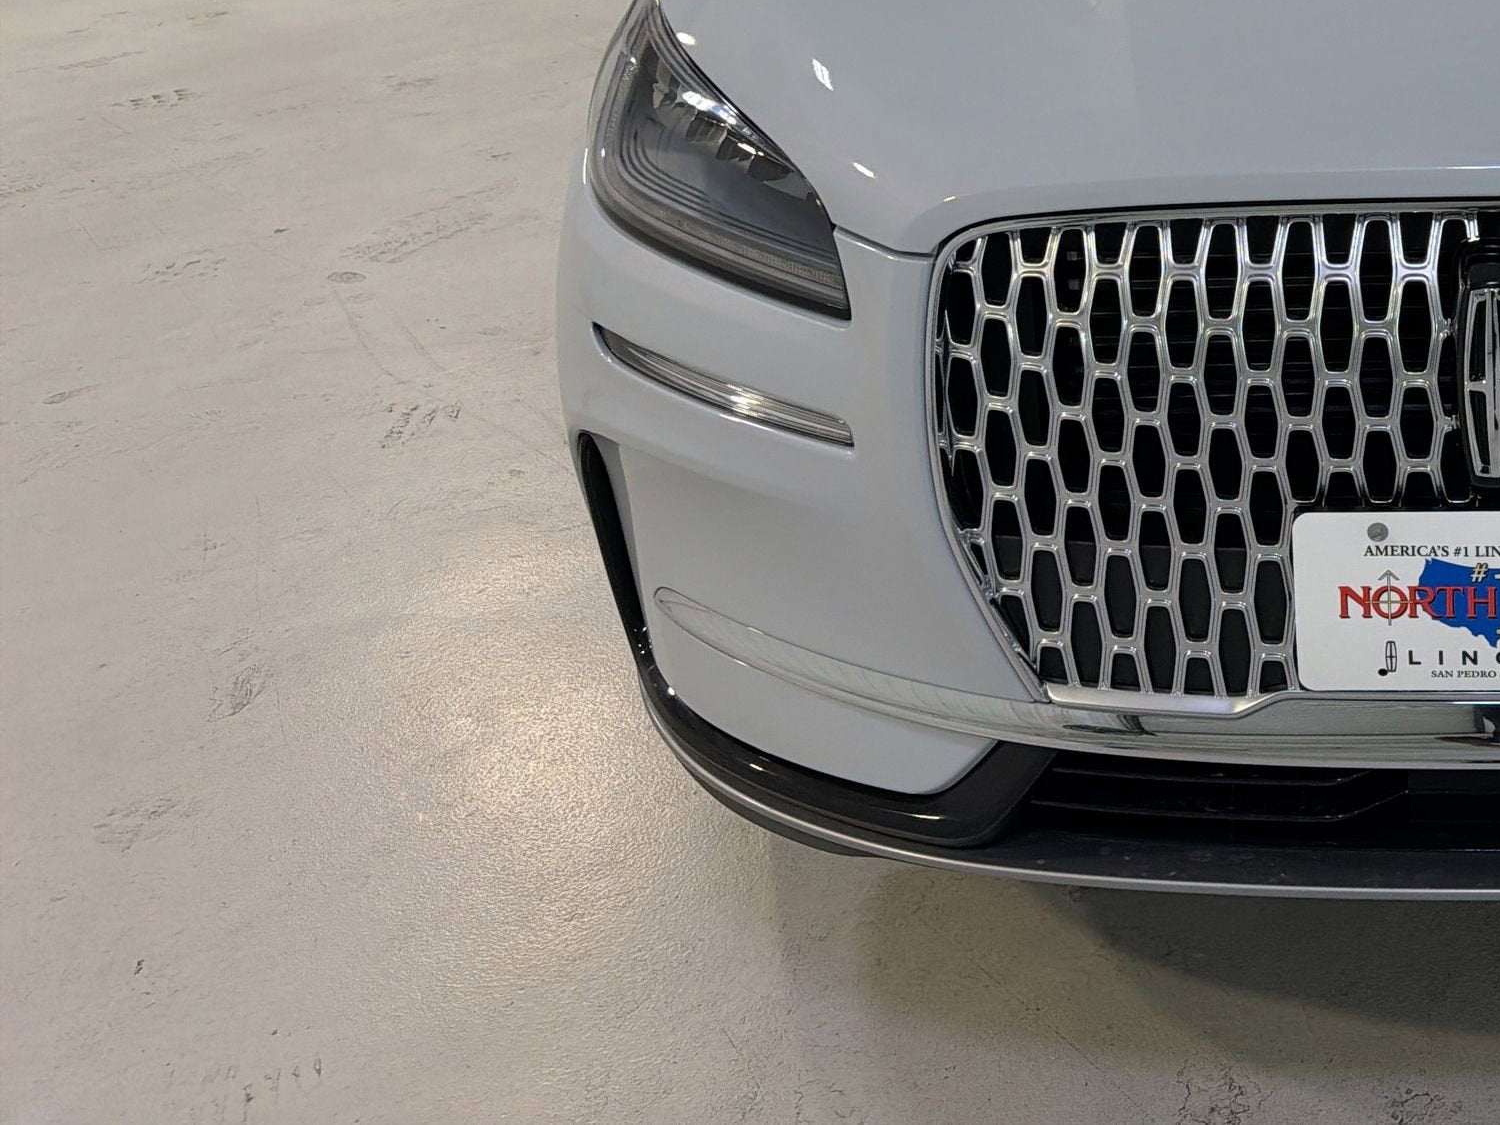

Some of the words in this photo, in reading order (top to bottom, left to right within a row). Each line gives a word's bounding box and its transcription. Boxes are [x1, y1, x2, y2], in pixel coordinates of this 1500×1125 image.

[1363, 545, 1450, 558] AMERICA'S
[1453, 546, 1470, 558] #1
[1337, 585, 1498, 620] NORTH
[1431, 670, 1454, 678] SAN
[1457, 670, 1497, 678] PEDRO
